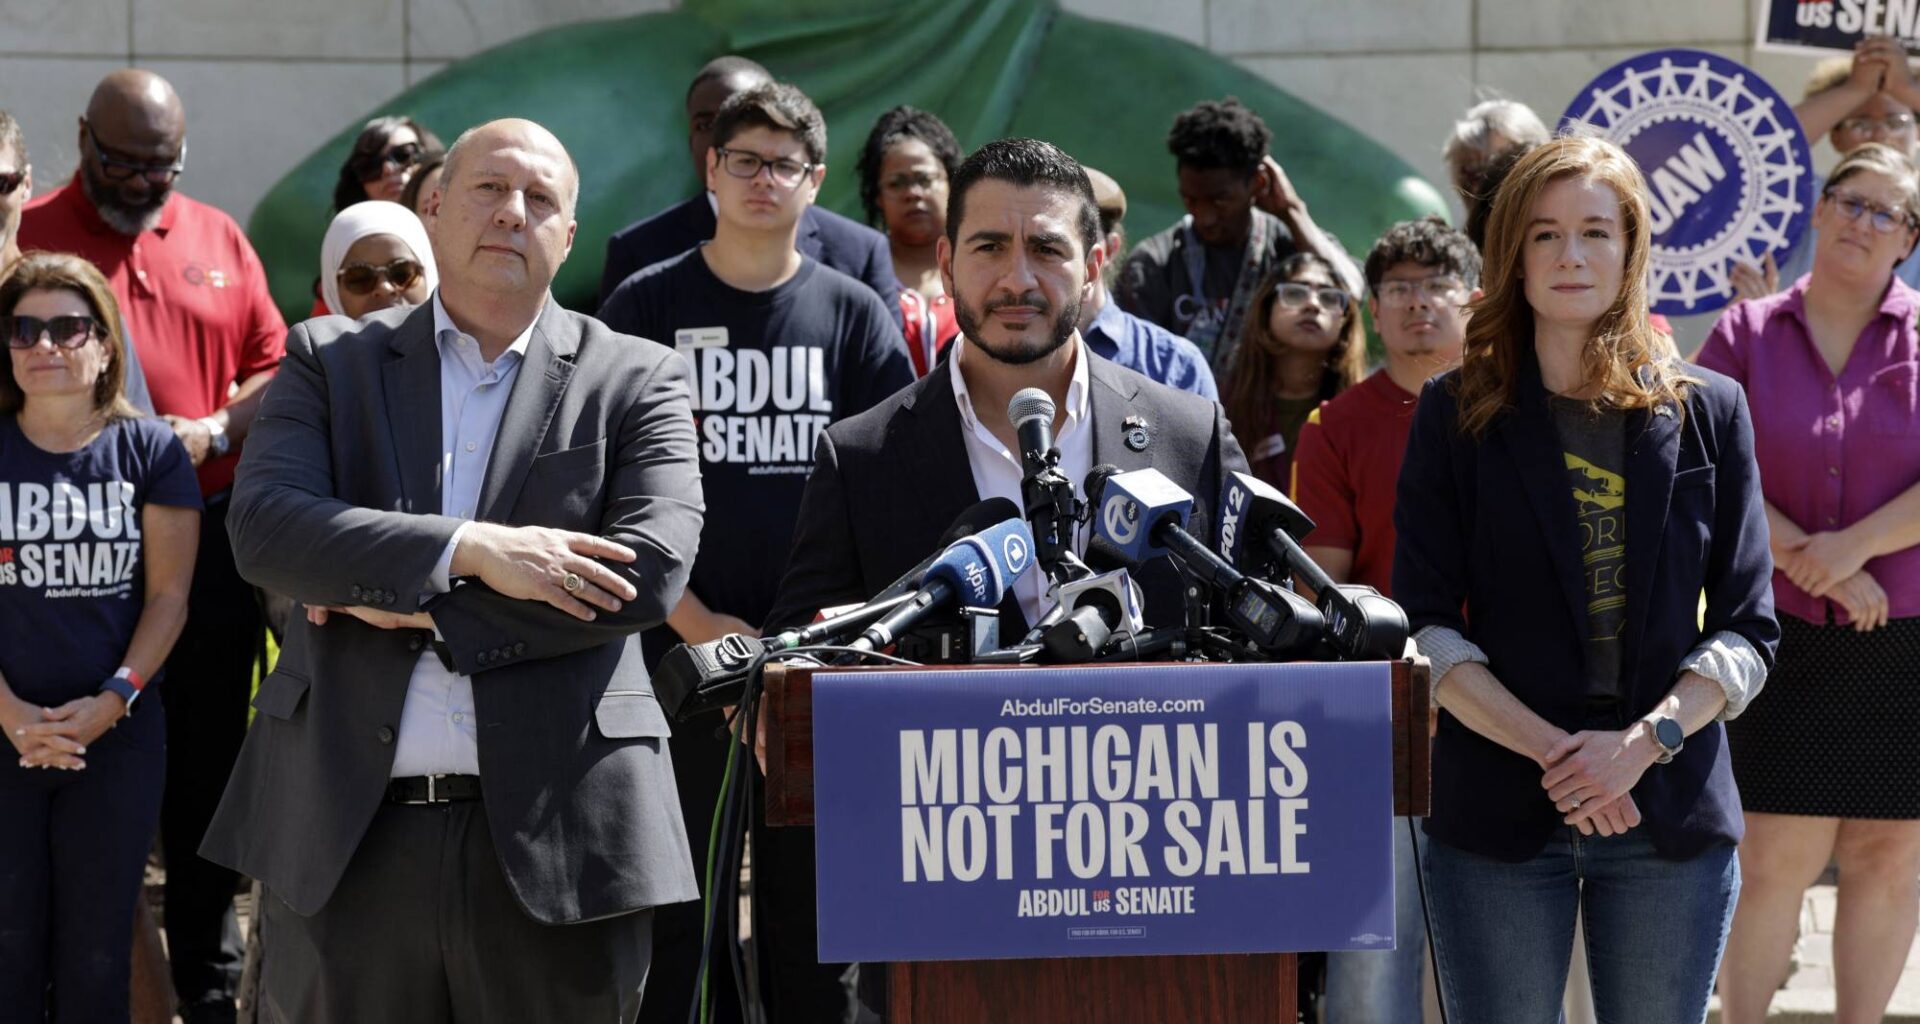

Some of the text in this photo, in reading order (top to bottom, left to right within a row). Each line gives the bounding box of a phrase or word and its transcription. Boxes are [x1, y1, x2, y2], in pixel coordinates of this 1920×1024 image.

[1835, 0, 1920, 38] SEN
[1221, 485, 1245, 565] FOX 2
[1000, 697, 1205, 717] AbdulForSenate.com
[900, 720, 1309, 806] MICHIGAN IS
[901, 798, 1311, 882] NOT FOR SALE
[1018, 886, 1196, 918] ABDUL FOR US SENATE
